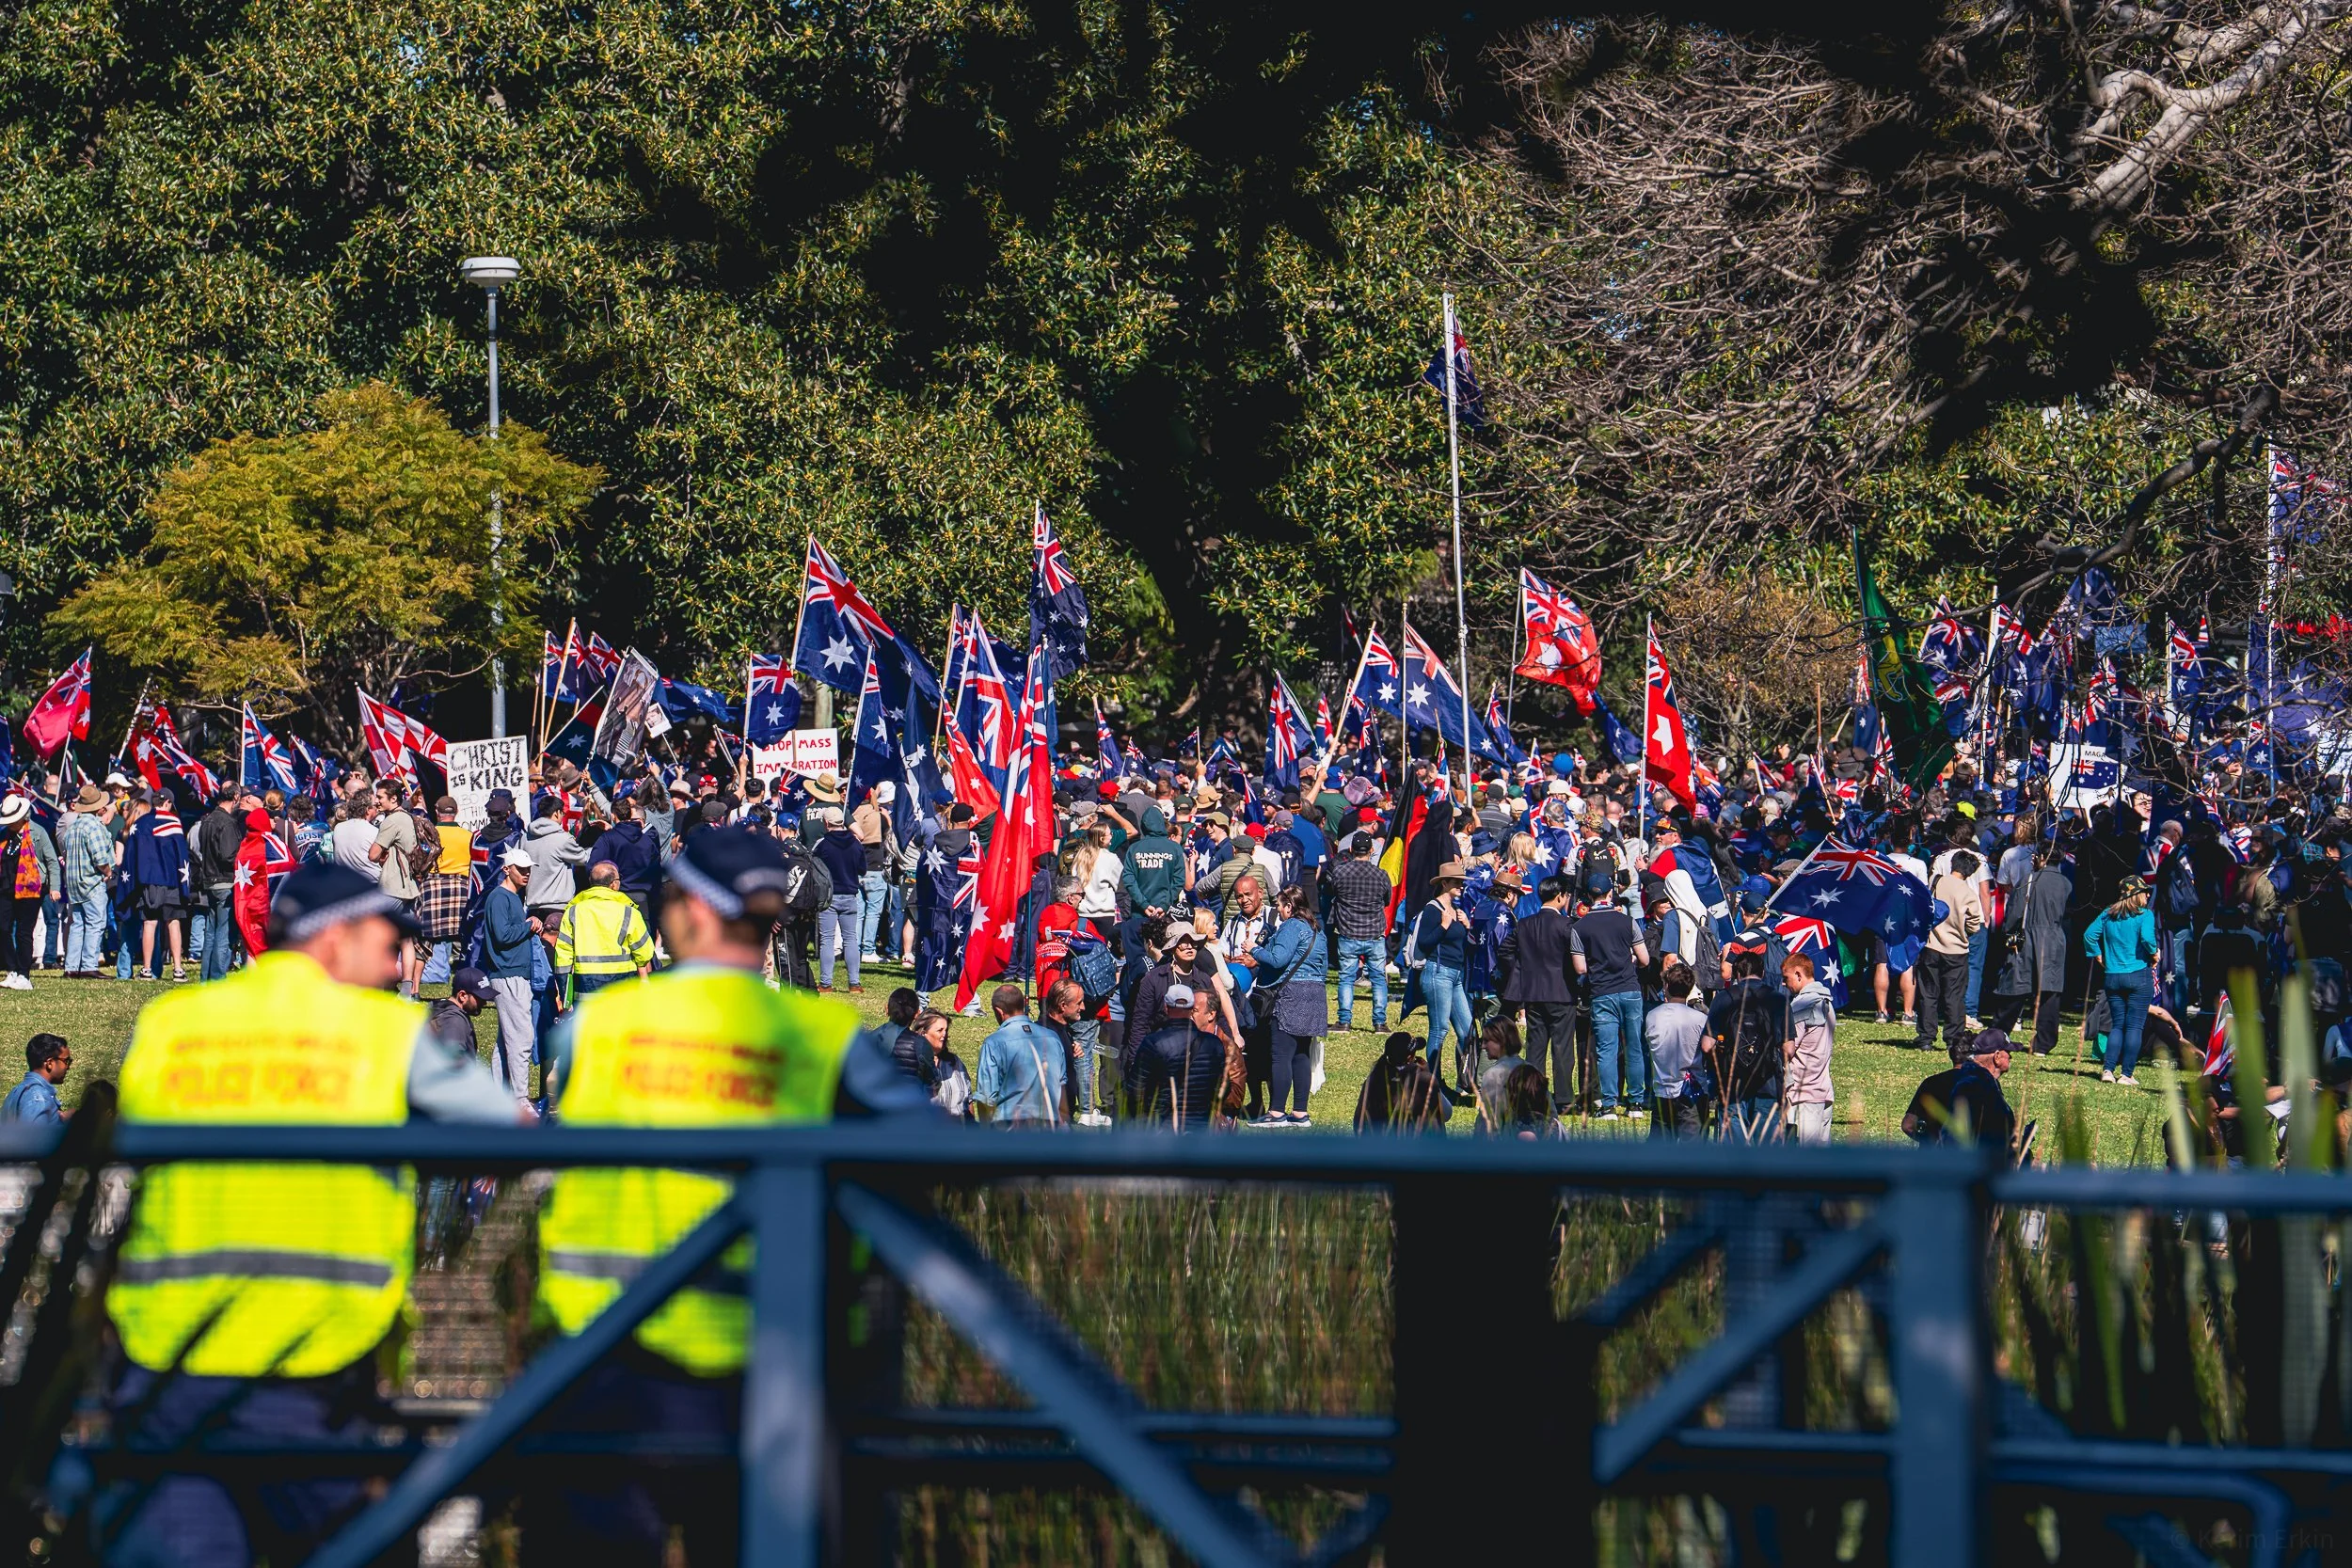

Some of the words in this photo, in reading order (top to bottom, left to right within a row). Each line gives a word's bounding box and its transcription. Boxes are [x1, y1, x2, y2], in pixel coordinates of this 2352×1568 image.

[798, 738, 832, 749] MASS
[451, 737, 525, 771] CHRIST
[451, 773, 466, 788] IS
[469, 766, 524, 792] KING
[1135, 852, 1173, 861] BUNNINGS
[1136, 859, 1164, 869] TRADE
